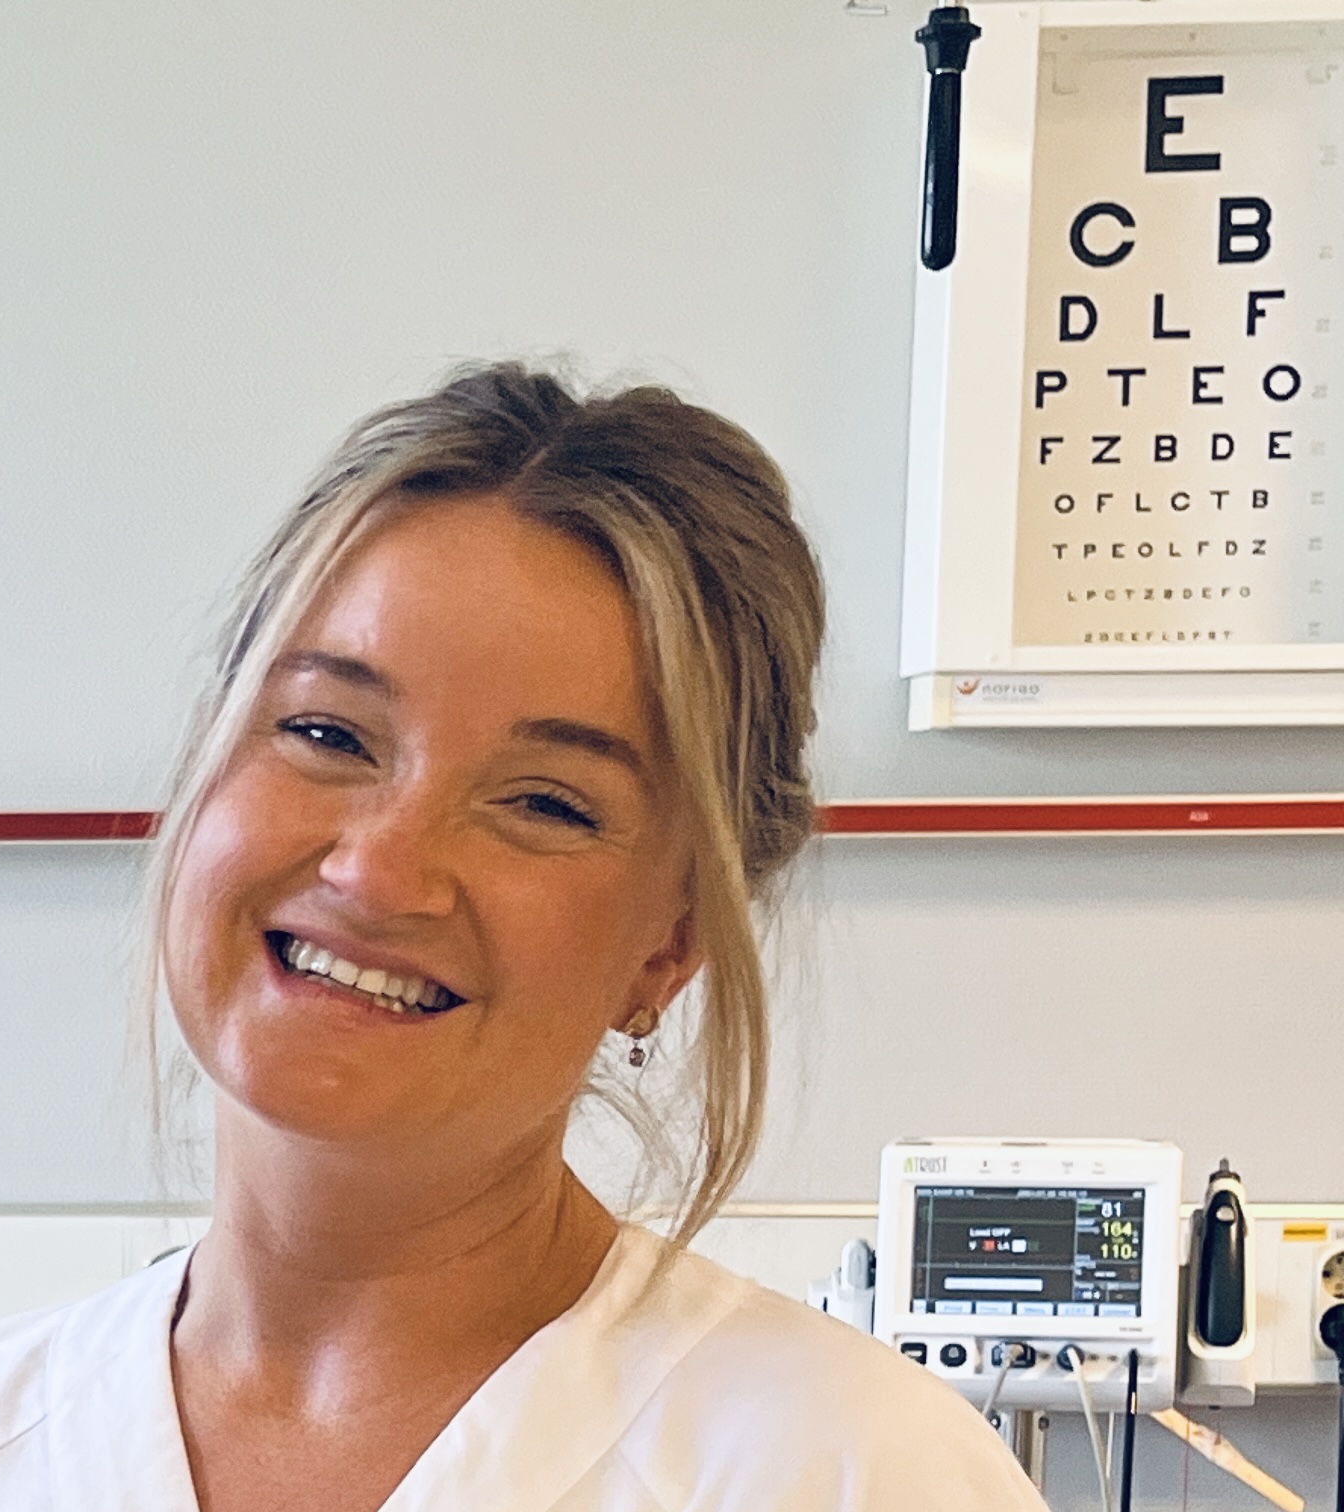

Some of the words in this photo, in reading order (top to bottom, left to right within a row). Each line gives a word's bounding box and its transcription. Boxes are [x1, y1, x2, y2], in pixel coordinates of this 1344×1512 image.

[1145, 75, 1224, 173] E
[1070, 202, 1135, 267] C
[1218, 197, 1272, 264] B
[1059, 295, 1097, 342] D
[1153, 294, 1190, 339] L
[1247, 290, 1285, 336] F
[1035, 370, 1067, 409] P
[1107, 368, 1146, 407] T
[1193, 366, 1225, 405] E
[1262, 364, 1301, 402] O
[1040, 437, 1064, 465] F
[1092, 436, 1121, 464] Z
[1154, 435, 1178, 463] B
[1212, 433, 1235, 462] D
[1268, 431, 1293, 460] E
[1054, 494, 1075, 514] O
[1097, 493, 1113, 513] F
[1136, 493, 1151, 512] L
[1170, 492, 1190, 512] C
[1210, 490, 1229, 510] T
[1252, 489, 1269, 509] B
